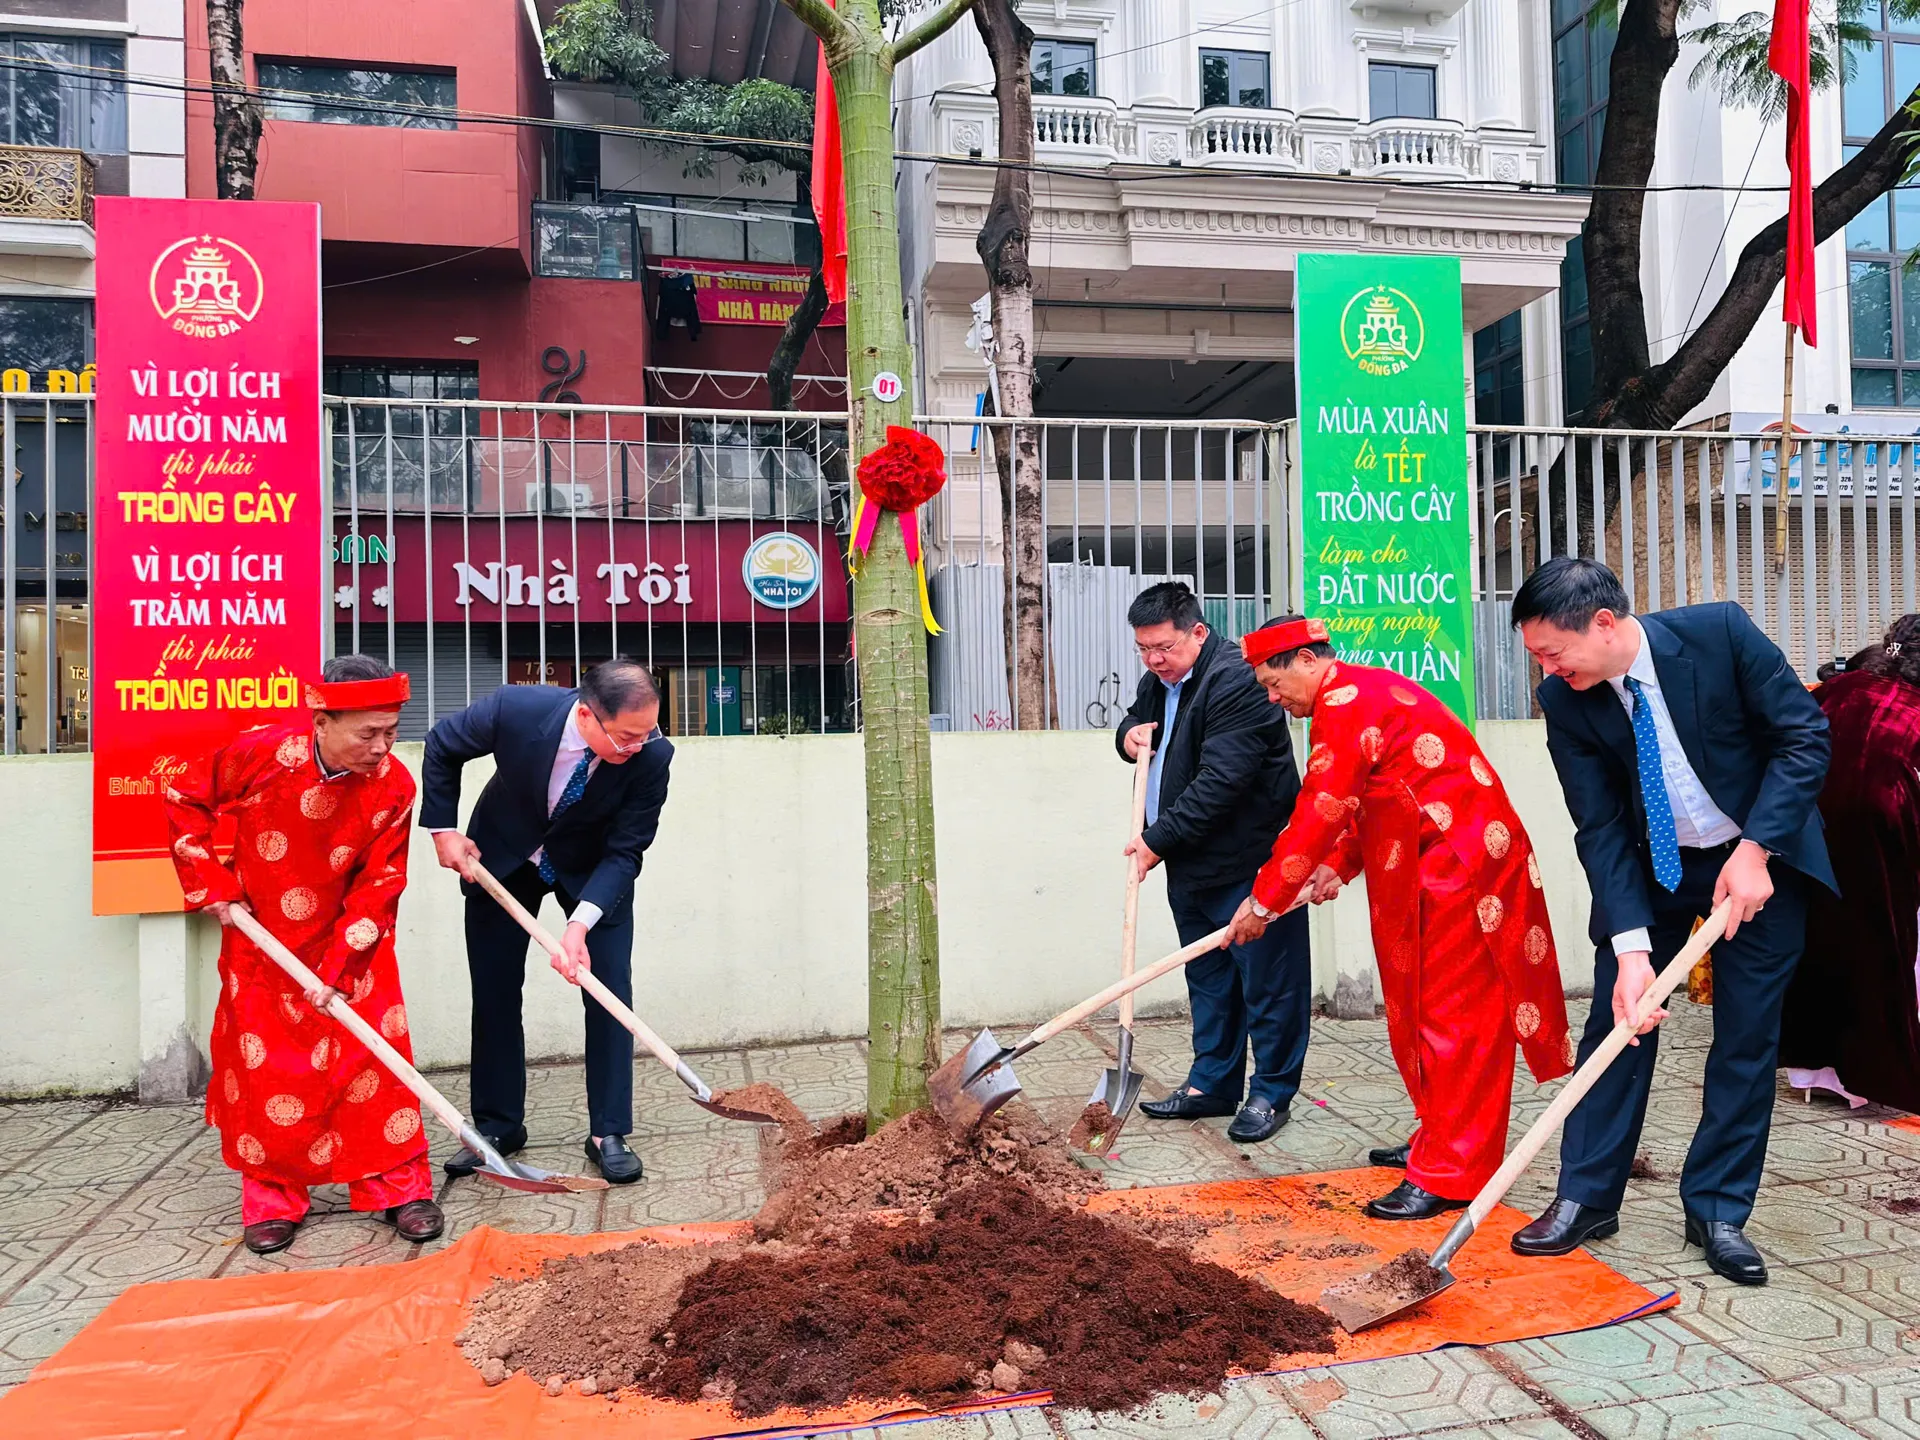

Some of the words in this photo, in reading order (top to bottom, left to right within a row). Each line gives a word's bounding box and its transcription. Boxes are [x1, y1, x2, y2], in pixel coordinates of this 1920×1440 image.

[173, 318, 217, 338] ĐỐNG
[217, 319, 241, 337] ĐA
[718, 299, 754, 320] NHÀ
[760, 301, 801, 321] HÀN
[130, 361, 158, 397] VÌ
[169, 366, 218, 406] LỢI
[229, 362, 281, 399] ÍCH
[1358, 358, 1391, 376] ĐỐNG
[1391, 359, 1409, 375] ĐA
[879, 378, 896, 396] 01
[127, 406, 212, 443] MƯỜI
[222, 409, 288, 443] NĂM
[1317, 397, 1377, 434] MÙA
[1382, 400, 1449, 435] XUÂN
[162, 448, 195, 476] thì
[195, 448, 256, 485] phải
[1354, 438, 1378, 470] là
[1382, 436, 1427, 483] TẾT
[117, 473, 225, 523] TRỒNG
[233, 481, 298, 523] CÂY
[1315, 476, 1404, 522] TRỒNG
[1411, 484, 1457, 522] CÂY
[131, 545, 159, 582] VÌ
[170, 551, 221, 591] LỢI
[231, 545, 284, 582] ÍCH
[1319, 535, 1366, 564] làm
[1371, 535, 1409, 564] cho
[452, 558, 580, 606] Nhà
[596, 561, 694, 605] Tôi
[1317, 560, 1368, 605] ĐẤT
[1377, 564, 1457, 605] NƯỚC
[130, 591, 211, 627] TRĂM
[221, 591, 287, 626] NĂM
[1381, 608, 1442, 645] ngày
[162, 634, 195, 661] thì
[195, 633, 257, 671] phải
[525, 661, 555, 676] 176
[1335, 642, 1375, 666] àng
[1379, 642, 1460, 681] XUÂN
[114, 660, 208, 711] TRỒNG
[216, 664, 299, 709] NGƯỜI
[150, 755, 189, 776] Xuâ
[108, 776, 155, 797] Bính
